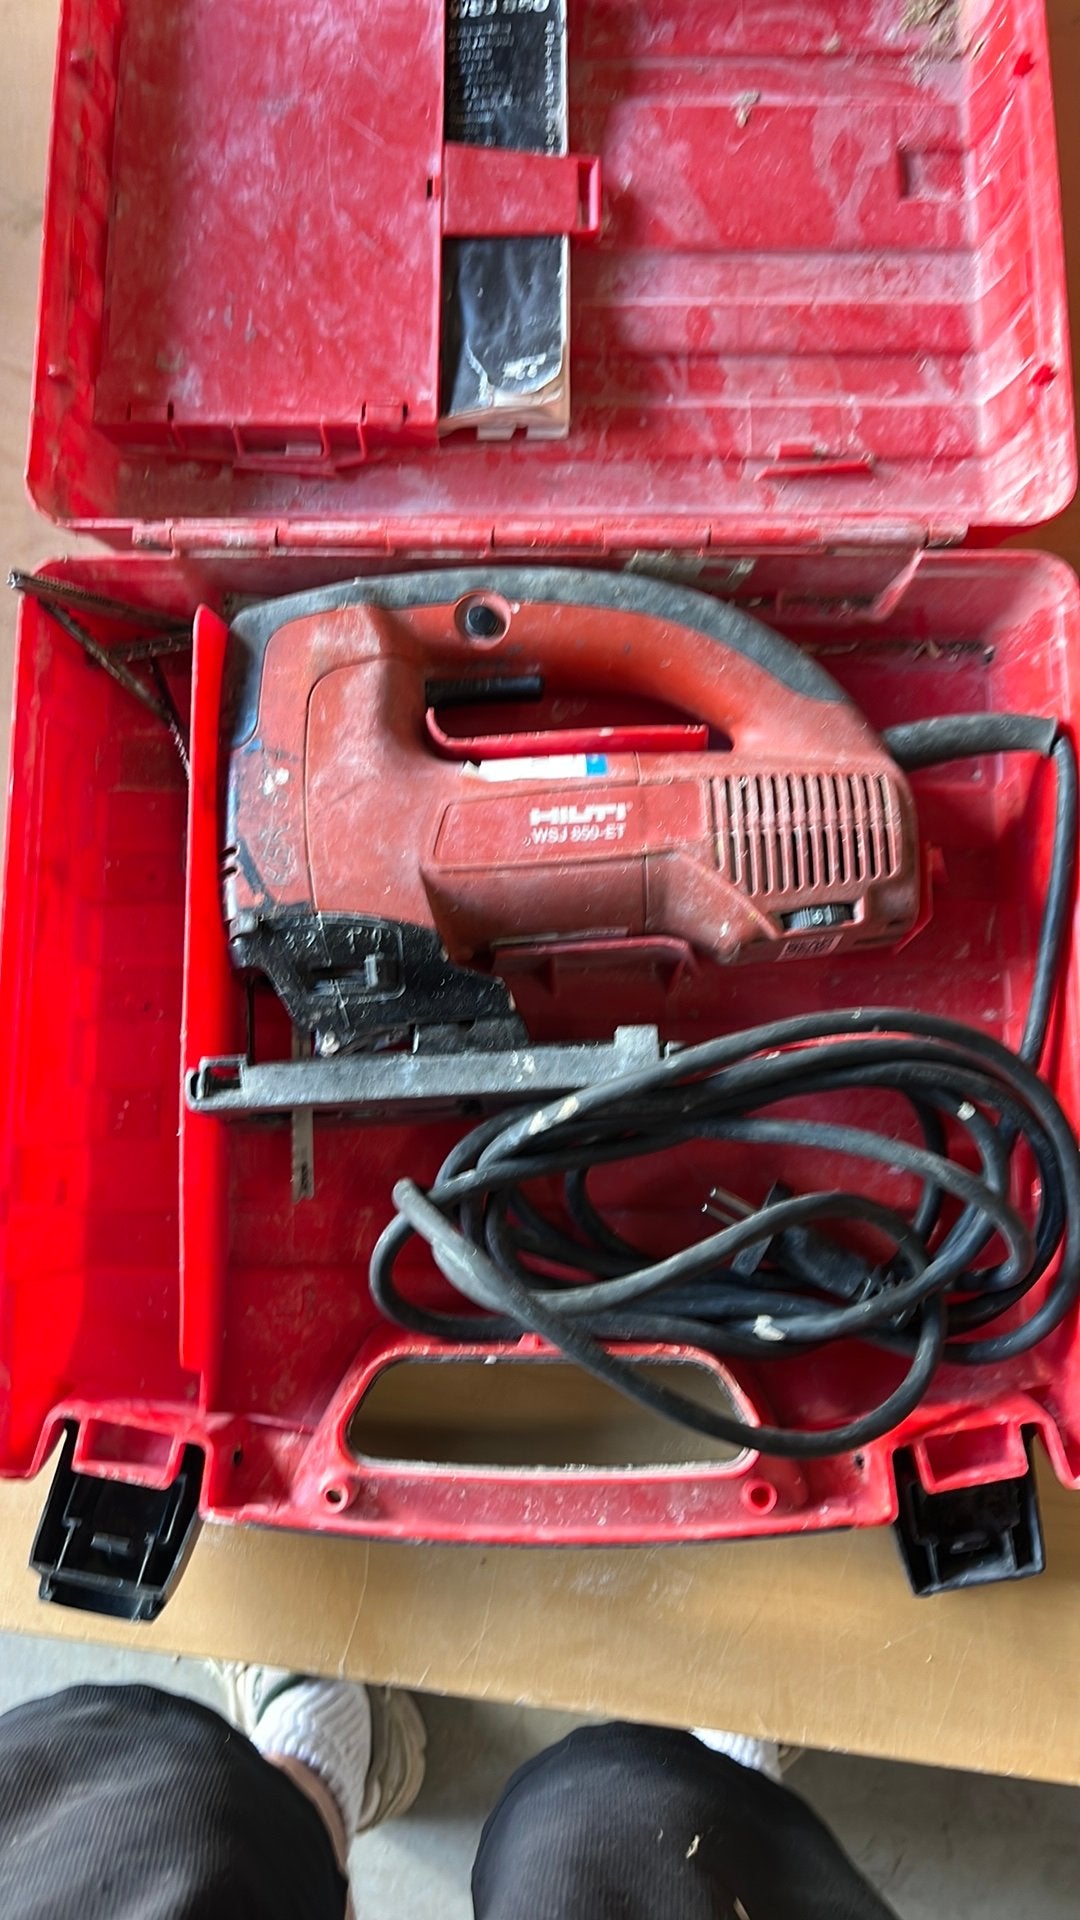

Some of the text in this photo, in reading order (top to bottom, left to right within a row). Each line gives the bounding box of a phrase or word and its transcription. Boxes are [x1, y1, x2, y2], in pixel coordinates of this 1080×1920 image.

[530, 803, 627, 826] HILTI
[531, 823, 626, 844] WSJ 850-ET
